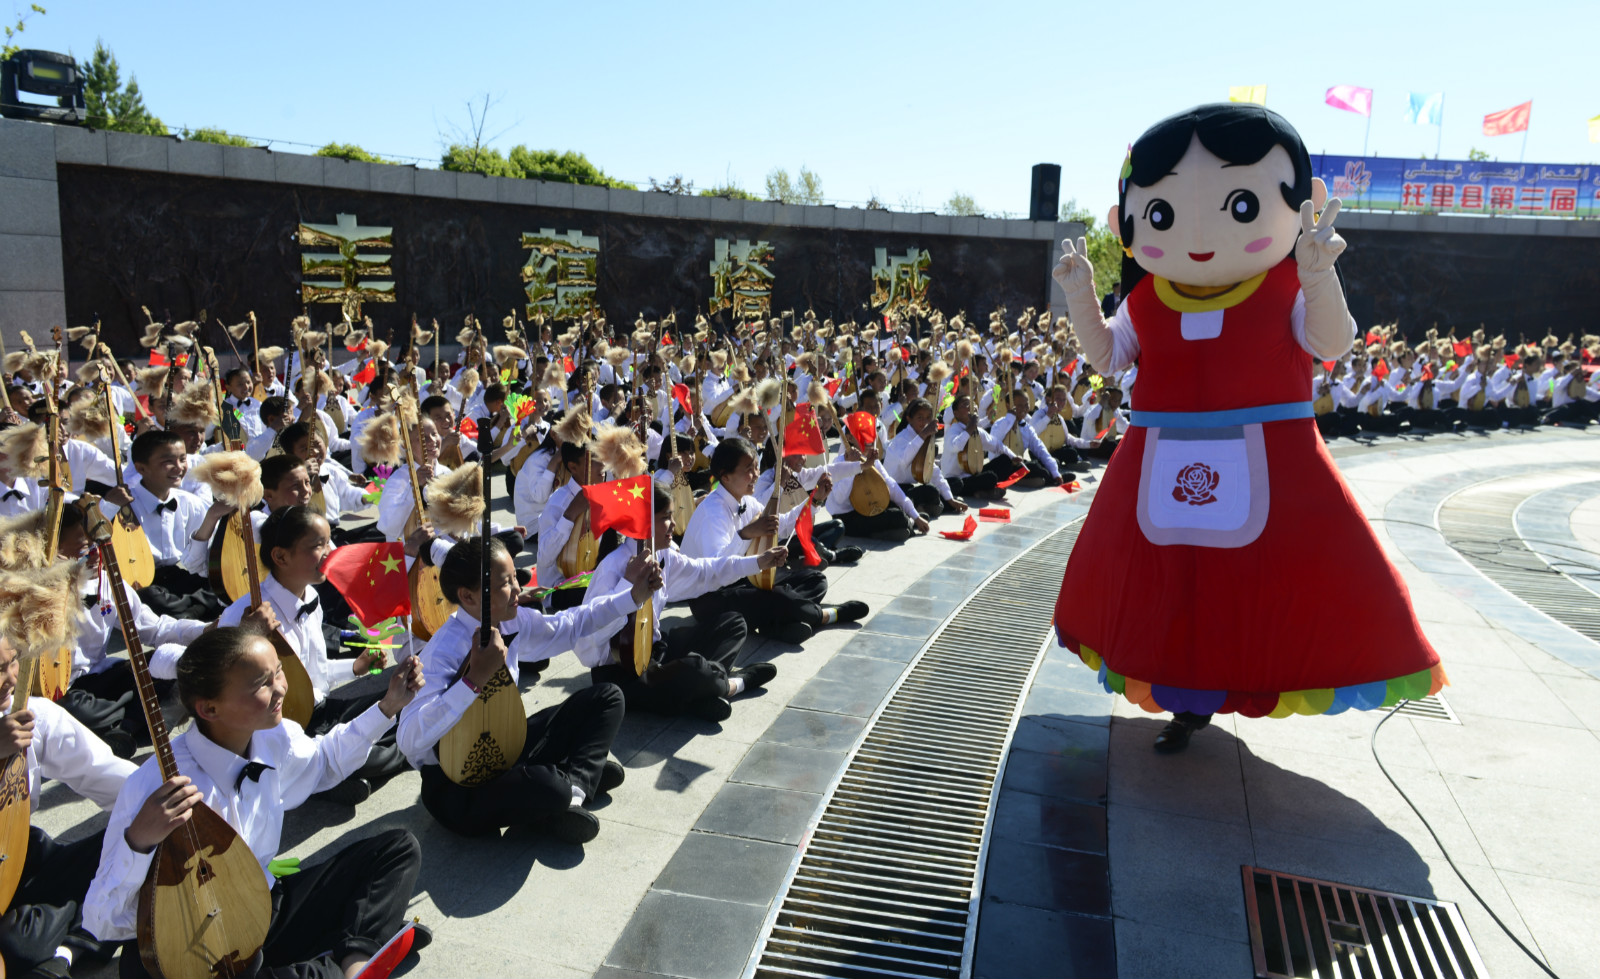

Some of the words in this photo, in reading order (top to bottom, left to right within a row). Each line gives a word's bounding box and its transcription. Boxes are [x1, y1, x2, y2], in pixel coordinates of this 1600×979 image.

[1402, 183, 1578, 212] 托里县第三届
[299, 213, 932, 322] 丰蕴塔城
